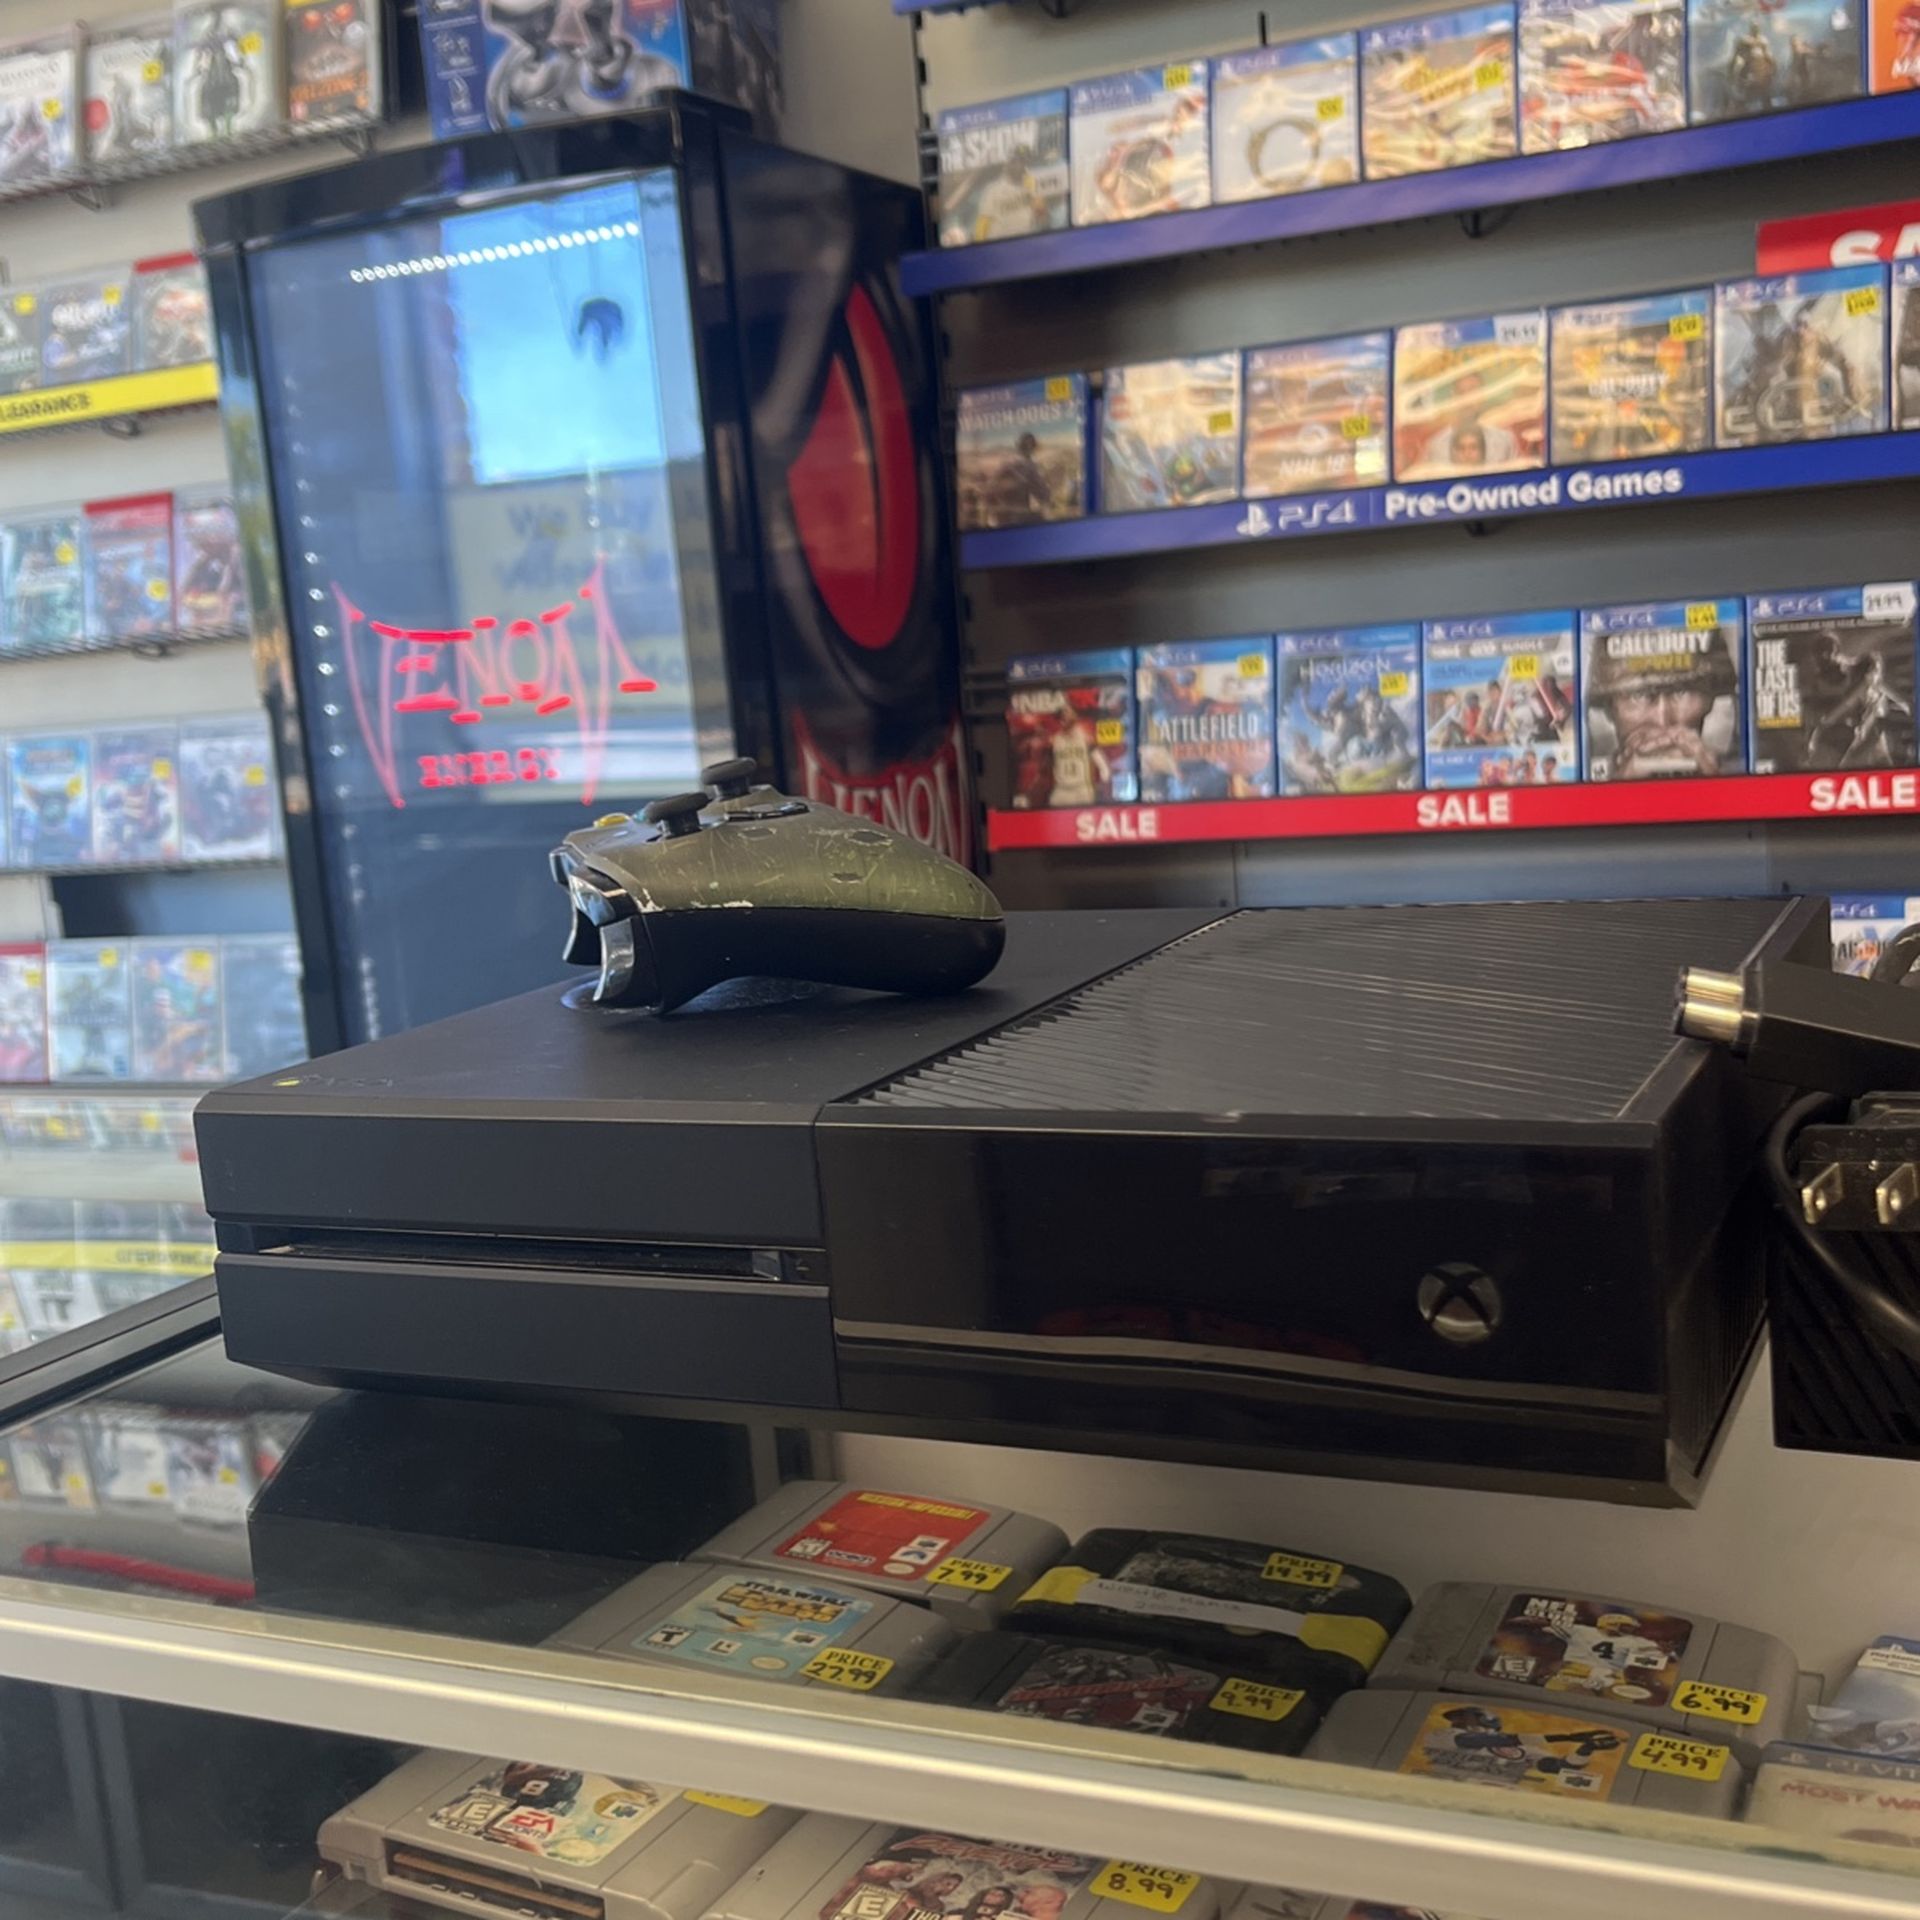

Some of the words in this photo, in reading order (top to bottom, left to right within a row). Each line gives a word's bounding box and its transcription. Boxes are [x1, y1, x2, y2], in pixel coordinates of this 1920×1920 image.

[1385, 476, 1559, 520] Pre-Owned
[1566, 467, 1684, 502] Games
[1278, 500, 1356, 529] PS4
[1606, 632, 1650, 659] CALL
[1660, 630, 1712, 654] DUTY
[1756, 638, 1788, 668] THE
[331, 553, 658, 808] VENOM
[1756, 665, 1798, 691] LAST
[1756, 692, 1777, 719] OF
[1778, 689, 1801, 718] US
[1810, 774, 1917, 811] SALE
[1416, 792, 1511, 826] SALE
[1076, 809, 1158, 842] SALE
[937, 1567, 988, 1585] 7.99
[950, 1558, 1004, 1574] PRICE
[743, 1580, 791, 1597] STAR
[794, 1590, 854, 1607] WARS
[1526, 1597, 1577, 1616] NFL
[827, 1650, 887, 1670] PRICE
[1591, 1640, 1616, 1660] 4
[806, 1661, 878, 1684] 27.99
[1219, 1690, 1274, 1712] 9.99
[1232, 1681, 1301, 1700] PRICE
[1689, 1683, 1760, 1703] PRICE
[1680, 1693, 1752, 1716] 6.99
[1640, 1747, 1709, 1771] 4.99
[1648, 1737, 1721, 1759] PRICE
[1781, 1780, 1868, 1803] MOST
[502, 1822, 549, 1840] SPORTS
[1107, 1873, 1174, 1899] 8.99
